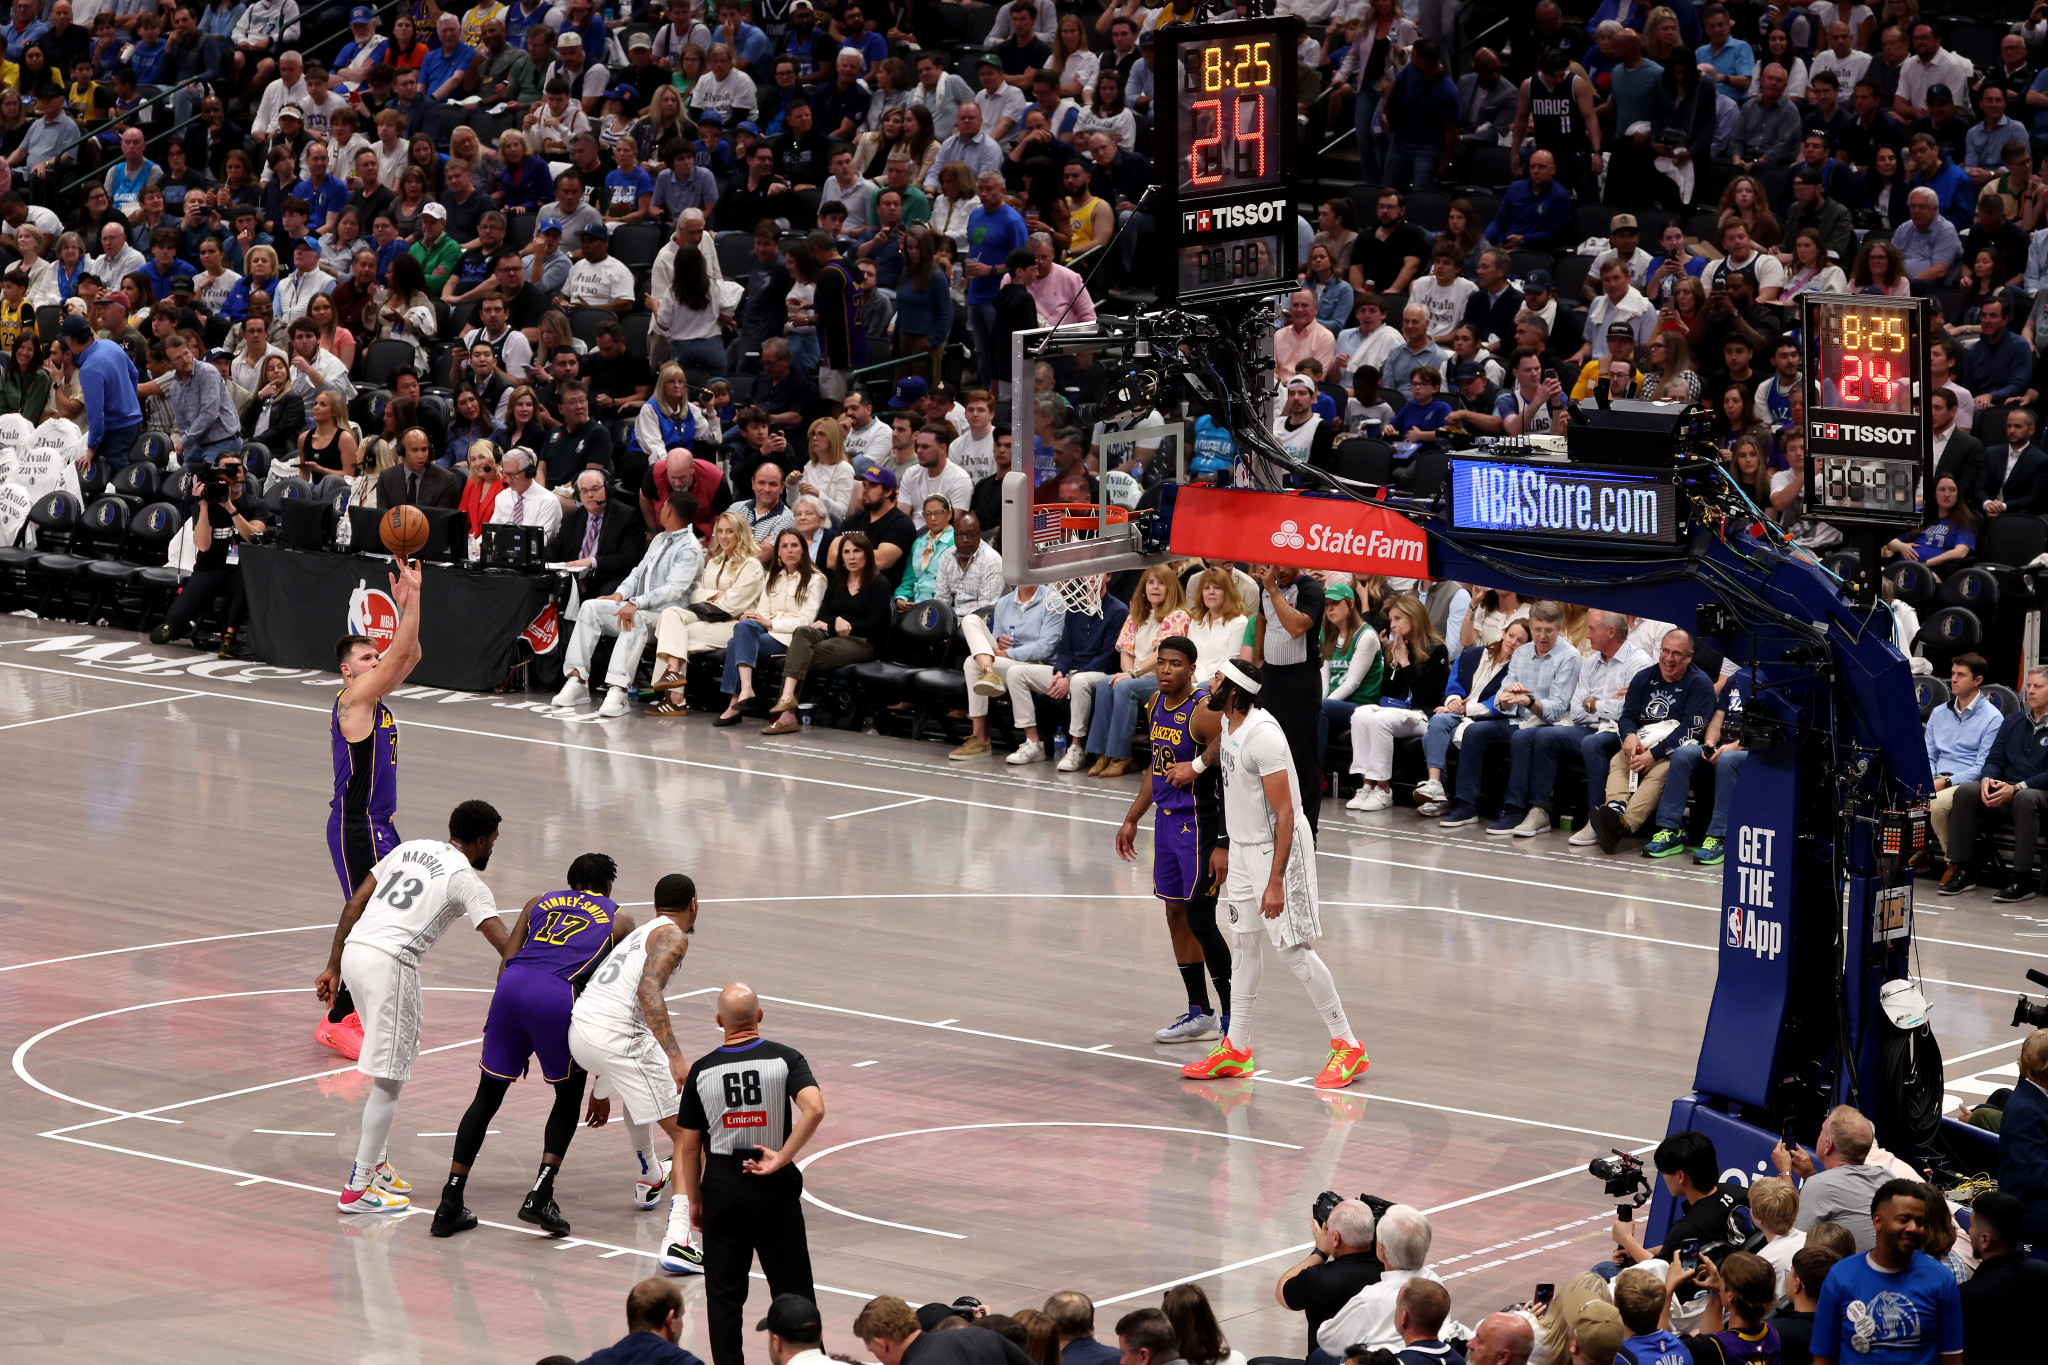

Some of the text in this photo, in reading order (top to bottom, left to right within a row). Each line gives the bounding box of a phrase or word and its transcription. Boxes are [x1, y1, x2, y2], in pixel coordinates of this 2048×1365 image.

[1204, 41, 1271, 92] 8:25
[1532, 98, 1570, 116] MAVS
[1191, 93, 1265, 185] 24
[1560, 116, 1572, 134] 11
[1212, 199, 1287, 230] TISSOT
[1843, 314, 1906, 353] 8:25
[1840, 354, 1893, 402] 24
[1840, 424, 1916, 446] TISSOT
[18, 466, 31, 475] za
[33, 466, 48, 475] vse
[1471, 466, 1658, 535] NBAStore.com
[367, 628, 393, 640] ESPN
[380, 615, 394, 629] NBA
[1150, 721, 1183, 745] LAKERS
[1152, 743, 1177, 776] 28
[1738, 825, 1776, 867] GET
[402, 850, 445, 880] MARSHALL
[376, 869, 425, 911] 13
[1737, 866, 1775, 909] THE
[538, 897, 611, 925] FINNEY-SMITH
[533, 910, 591, 946] 17
[1743, 909, 1782, 960] App
[594, 952, 627, 985] 5
[722, 1069, 763, 1109] 68
[726, 1112, 764, 1125] Emirates
